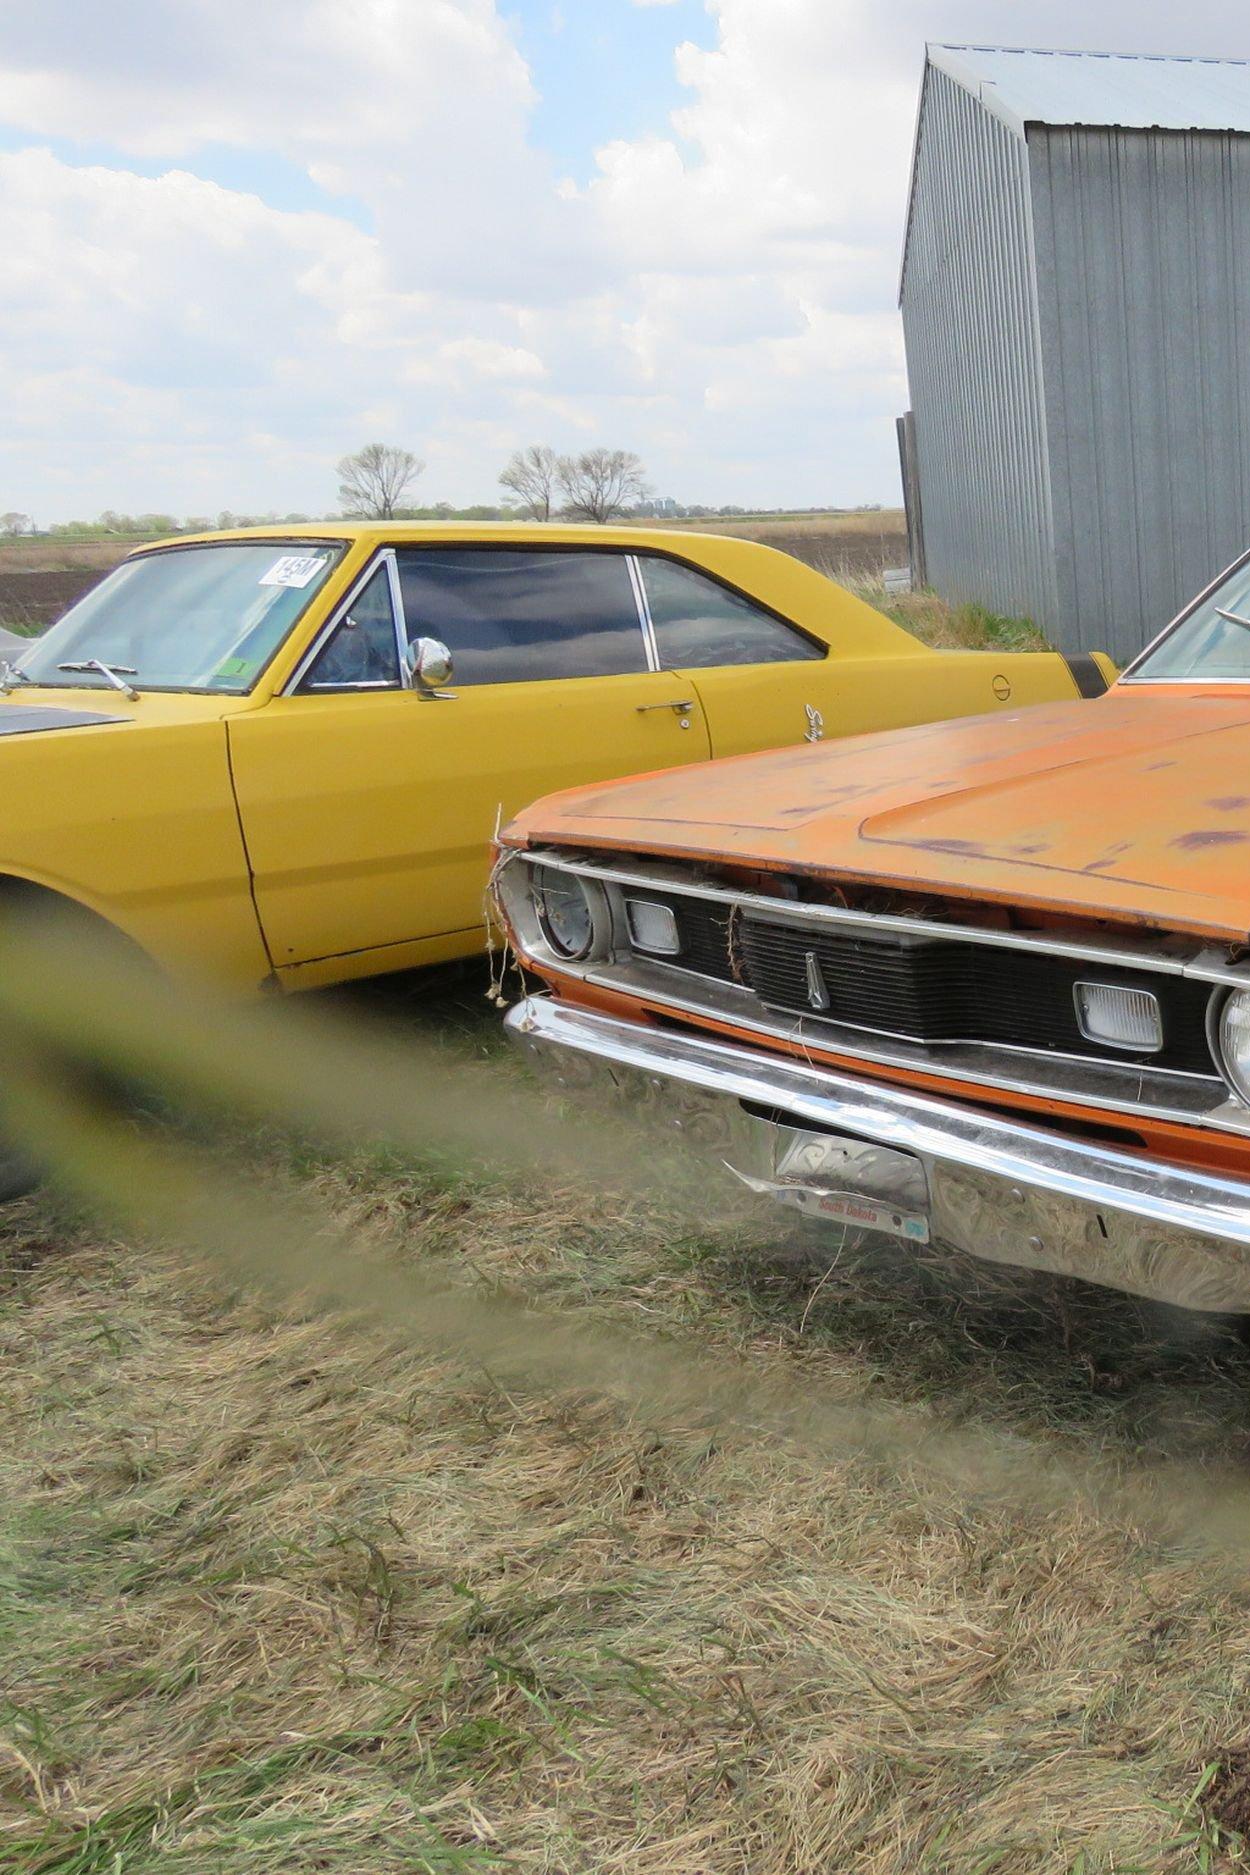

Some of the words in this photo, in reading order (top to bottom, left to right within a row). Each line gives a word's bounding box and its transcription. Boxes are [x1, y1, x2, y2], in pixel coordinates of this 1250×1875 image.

[276, 557, 319, 576] 145M
[818, 1197, 844, 1213] South
[846, 1203, 878, 1222] Dakota
